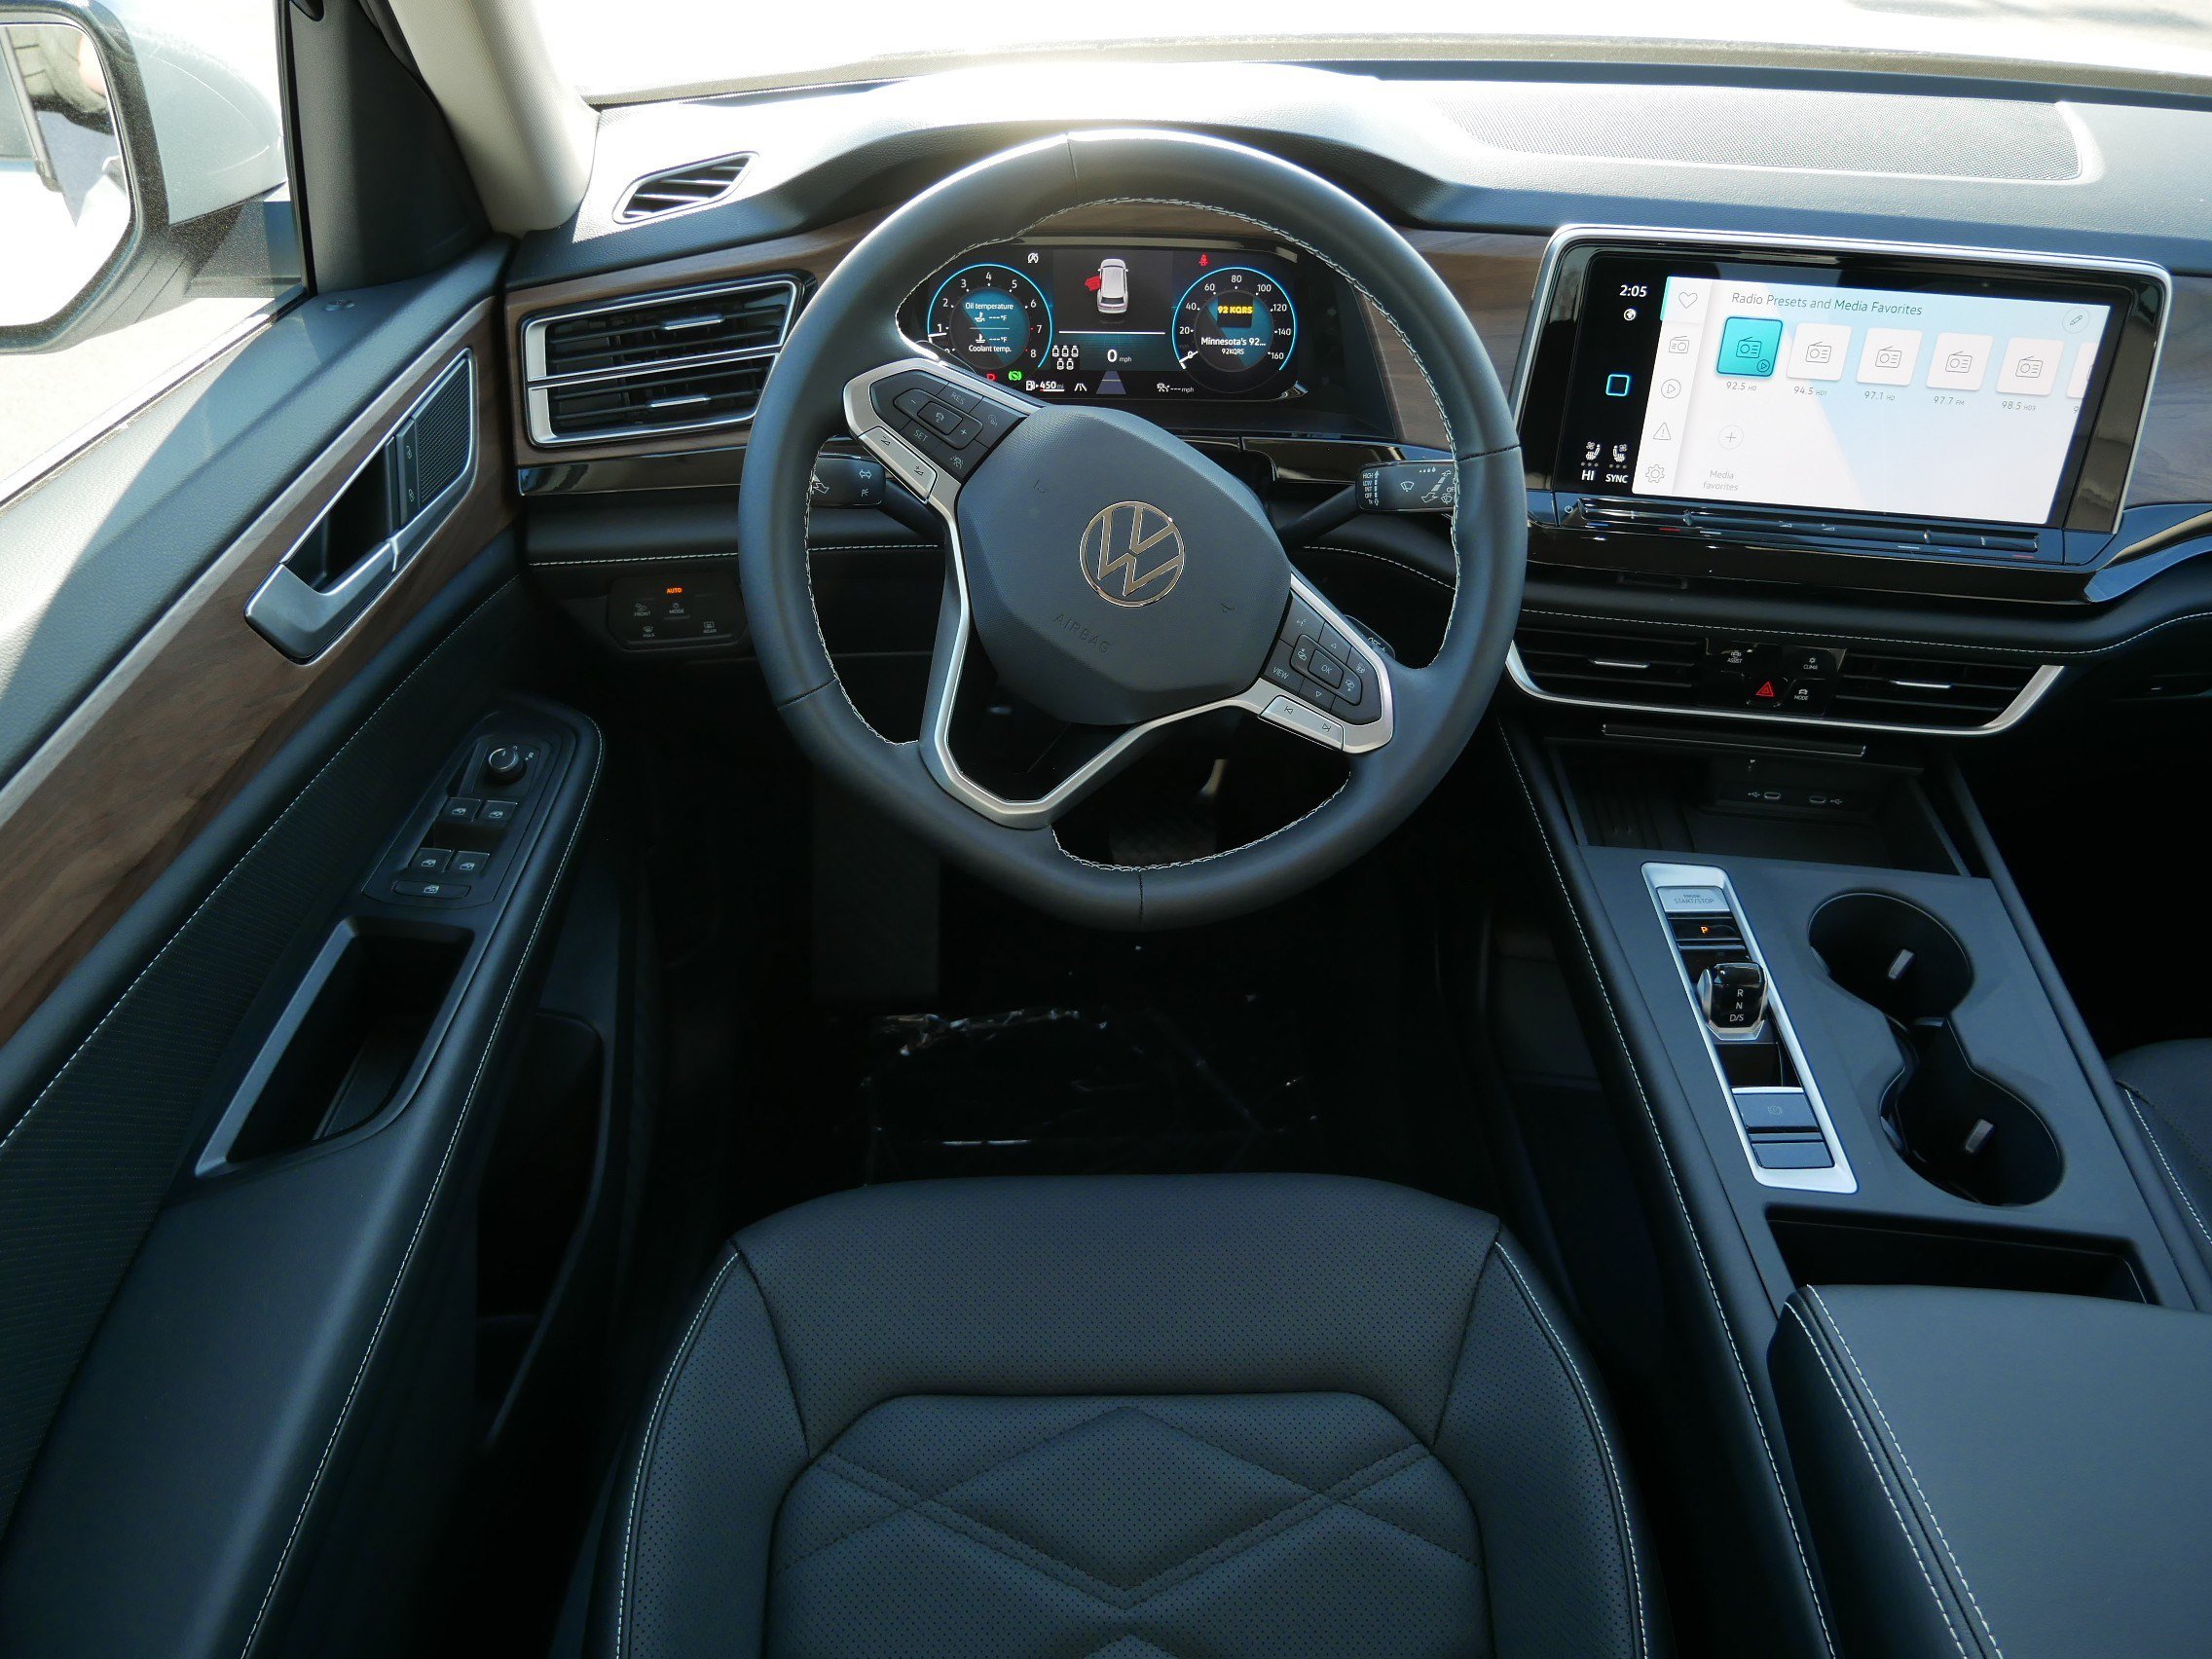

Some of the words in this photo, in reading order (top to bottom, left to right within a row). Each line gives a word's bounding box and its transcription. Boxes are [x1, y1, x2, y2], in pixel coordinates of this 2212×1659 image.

[986, 272, 992, 280] 4
[961, 279, 966, 288] 3
[1012, 280, 1017, 288] 5
[1620, 285, 1647, 297] 2:05
[943, 298, 948, 307] 2
[975, 302, 1014, 311] temperature
[1030, 299, 1036, 308] 6
[1732, 293, 1762, 305] Radio
[1766, 295, 1807, 308] Presets
[1811, 299, 1830, 309] and
[1834, 300, 1867, 312] Media
[1871, 302, 1923, 315] Favorites
[1217, 306, 1228, 314] 92
[1230, 306, 1253, 314] KQRS
[937, 324, 942, 332] 1
[1037, 325, 1042, 333] 7
[1201, 337, 1247, 345] Minnesota's
[991, 345, 1011, 353] temp.
[1030, 350, 1036, 358] 8
[1107, 349, 1117, 362] 0
[1040, 381, 1056, 389] 450
[1726, 381, 1745, 391] 92.5
[1794, 386, 1813, 395] 94.5
[951, 392, 965, 406] RES
[1864, 391, 1884, 400] 97.1
[1934, 396, 1953, 405] 97.7
[2002, 401, 2021, 410] 98.5
[914, 430, 928, 442] SET
[1581, 470, 1595, 481] HI
[1606, 473, 1628, 484] SYNC
[1710, 470, 1734, 479] Media
[1703, 481, 1738, 491] favorites
[1053, 613, 1110, 654] AIRBAG
[1272, 666, 1289, 680] VIEW
[1321, 664, 1332, 675] OK
[1729, 1014, 1744, 1022] D/S
